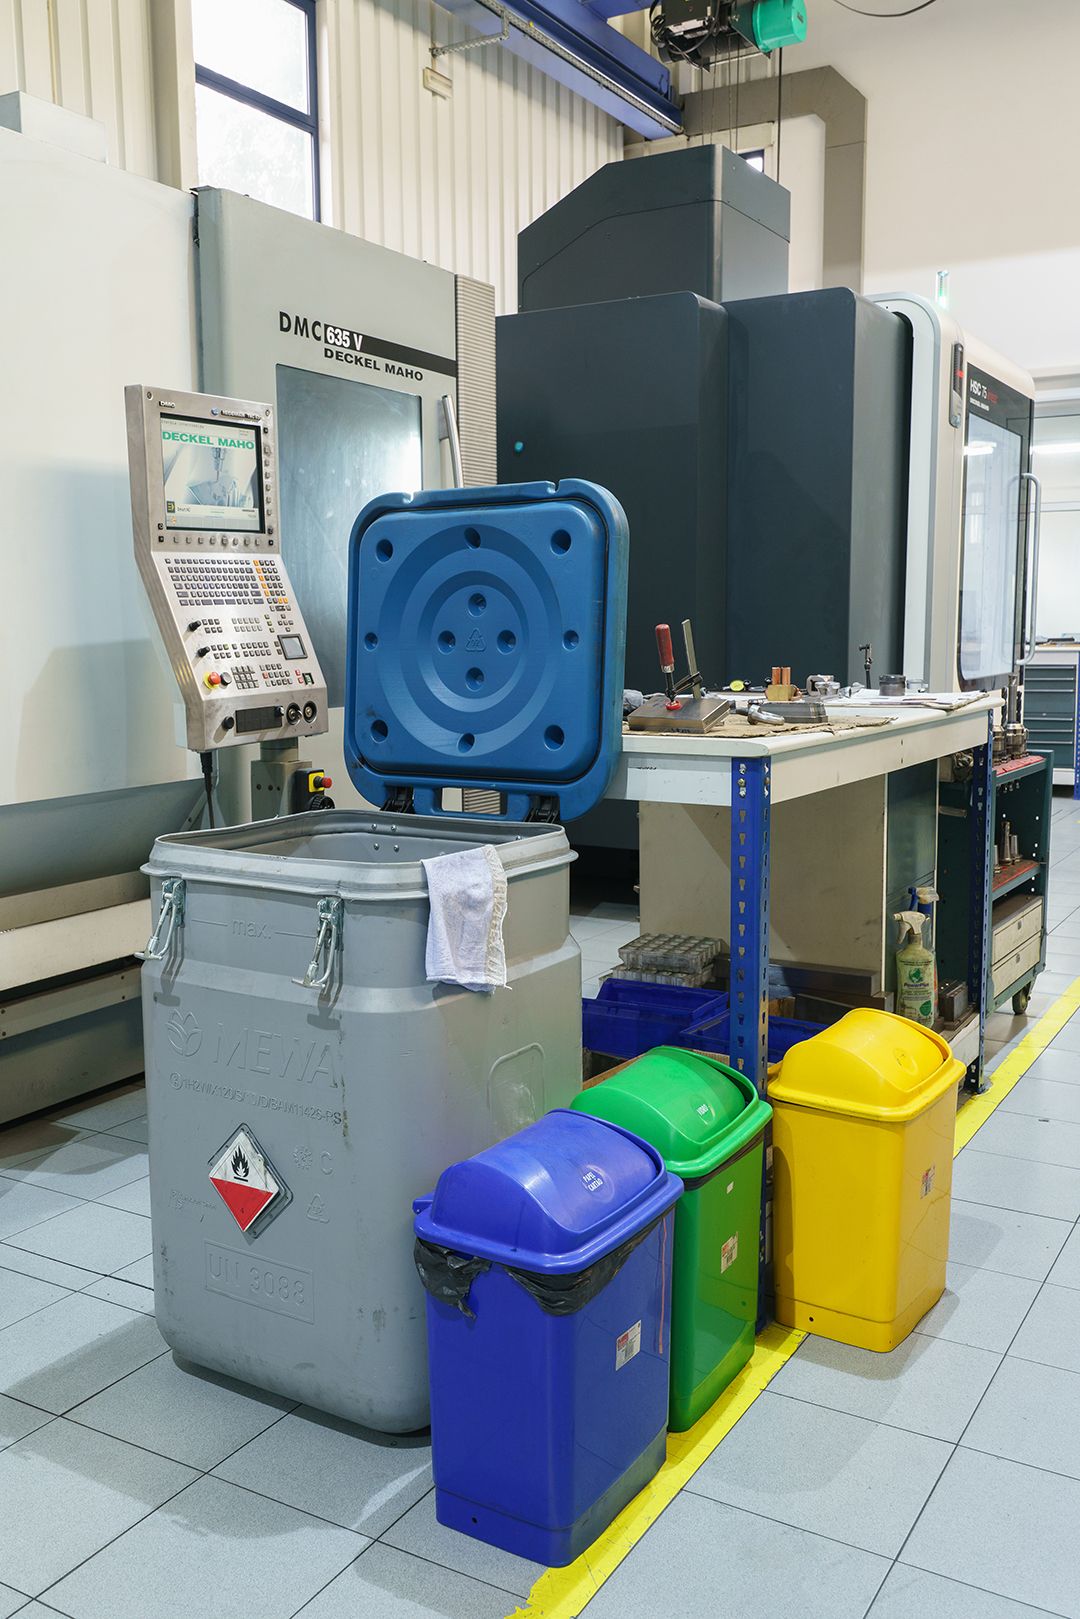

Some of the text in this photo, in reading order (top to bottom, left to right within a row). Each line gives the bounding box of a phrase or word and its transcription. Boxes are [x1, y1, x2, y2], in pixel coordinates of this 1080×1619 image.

[279, 311, 363, 351] DMC 635 V
[324, 348, 424, 381] DECKEL MAHO
[162, 431, 255, 450] DECKEL MAHO
[213, 1022, 338, 1088] MEWA
[249, 1266, 305, 1306] 3088
